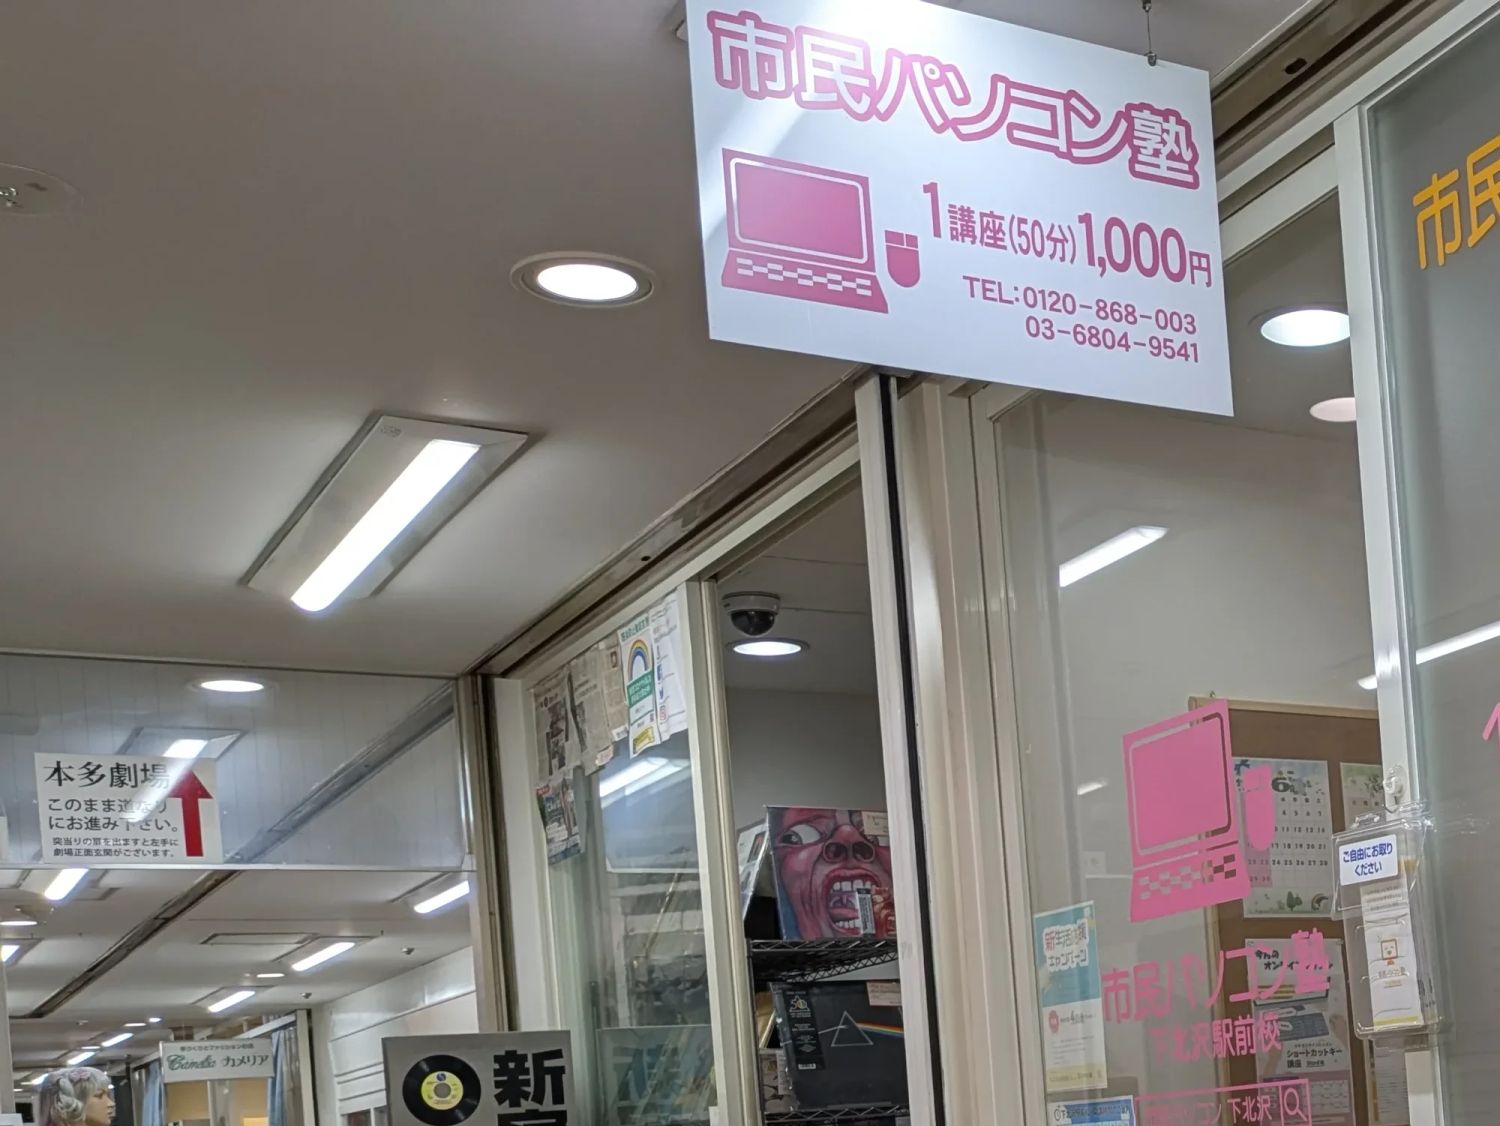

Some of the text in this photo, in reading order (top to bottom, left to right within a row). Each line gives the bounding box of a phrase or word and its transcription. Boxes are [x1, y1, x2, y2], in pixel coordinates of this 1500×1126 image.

[707, 10, 1200, 190] 市民パソコン塾
[1025, 315, 1199, 363] 03-6804-9541
[44, 760, 169, 789] 本多劇場
[1343, 842, 1393, 863] ご自由にお取り
[1354, 861, 1382, 876] ください
[223, 1055, 269, 1067] カメリア
[1227, 1095, 1272, 1124] 下北沢
